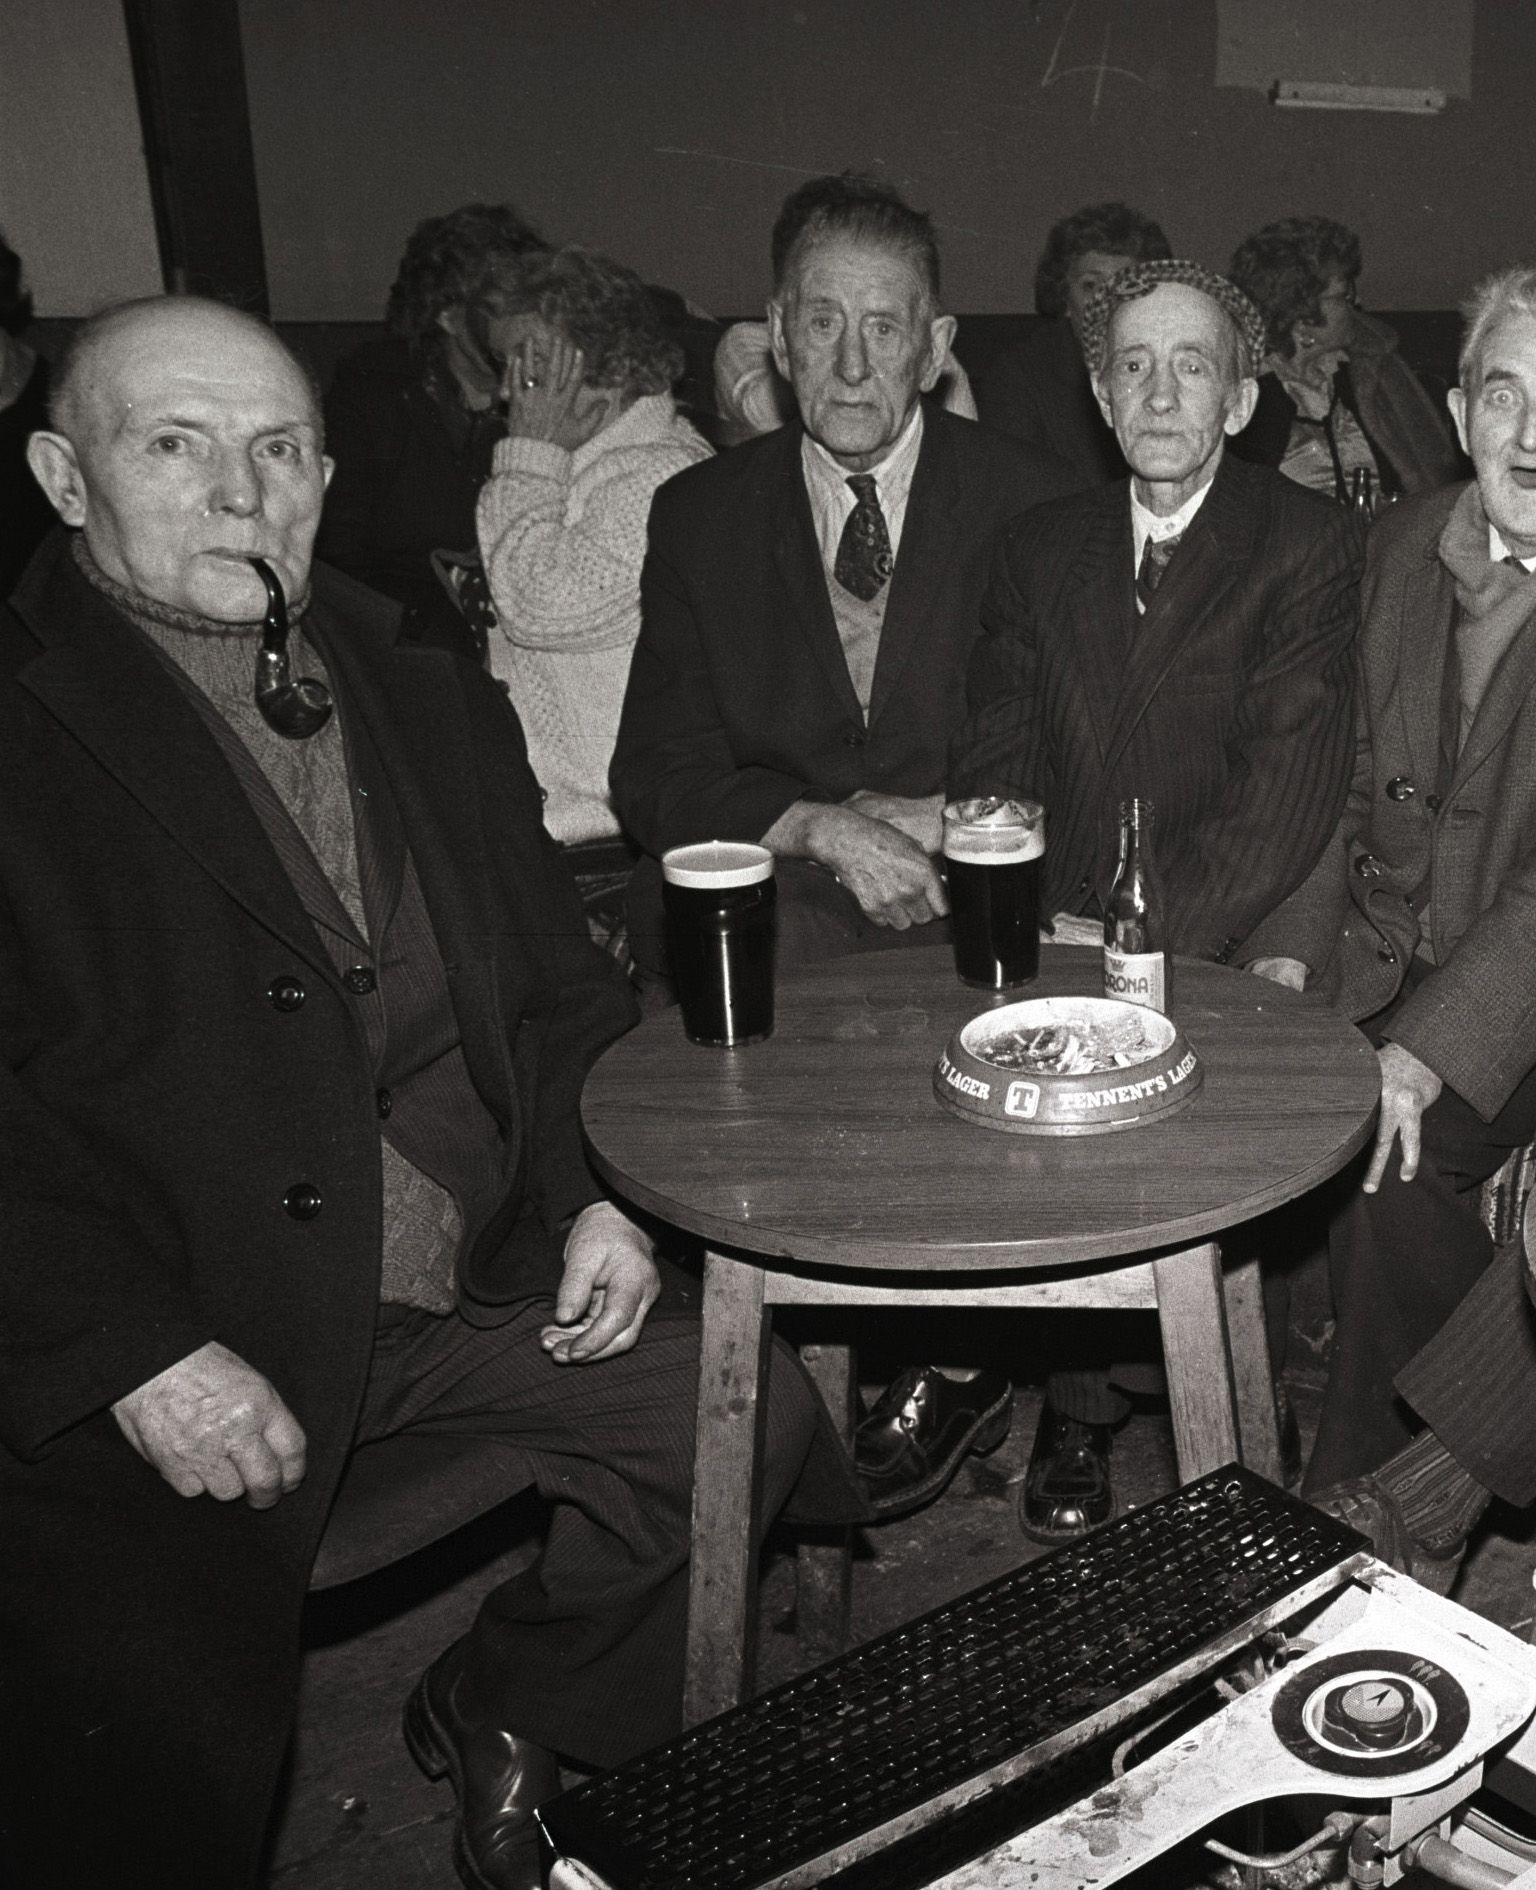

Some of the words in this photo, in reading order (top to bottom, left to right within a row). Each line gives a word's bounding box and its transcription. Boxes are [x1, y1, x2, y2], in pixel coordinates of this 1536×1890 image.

[1104, 970, 1149, 994] ORONA
[946, 1066, 991, 1100] LAGER
[1058, 1075, 1168, 1110] TENNENT'S
[1011, 1085, 1037, 1113] T
